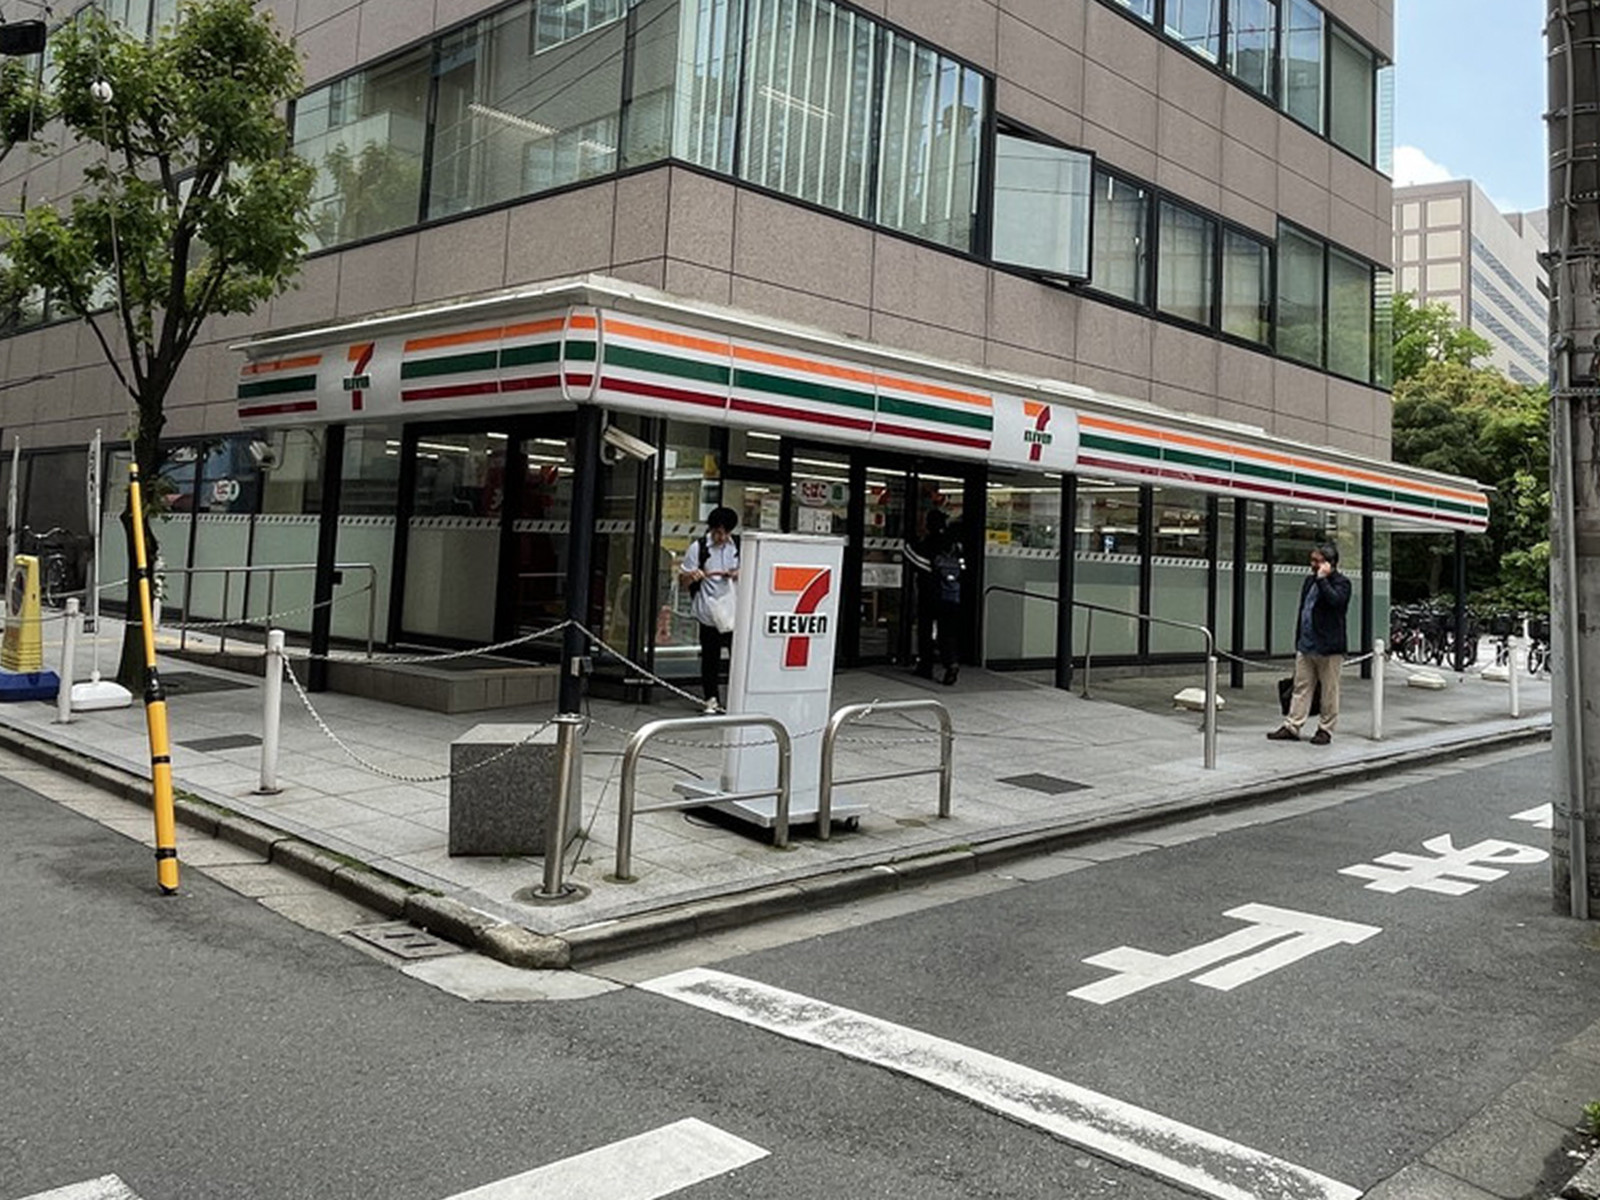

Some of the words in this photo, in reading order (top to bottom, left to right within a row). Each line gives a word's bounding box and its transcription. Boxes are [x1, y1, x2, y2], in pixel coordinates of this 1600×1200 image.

[347, 342, 375, 410] 7
[1023, 401, 1051, 461] 7
[774, 566, 831, 667] 7
